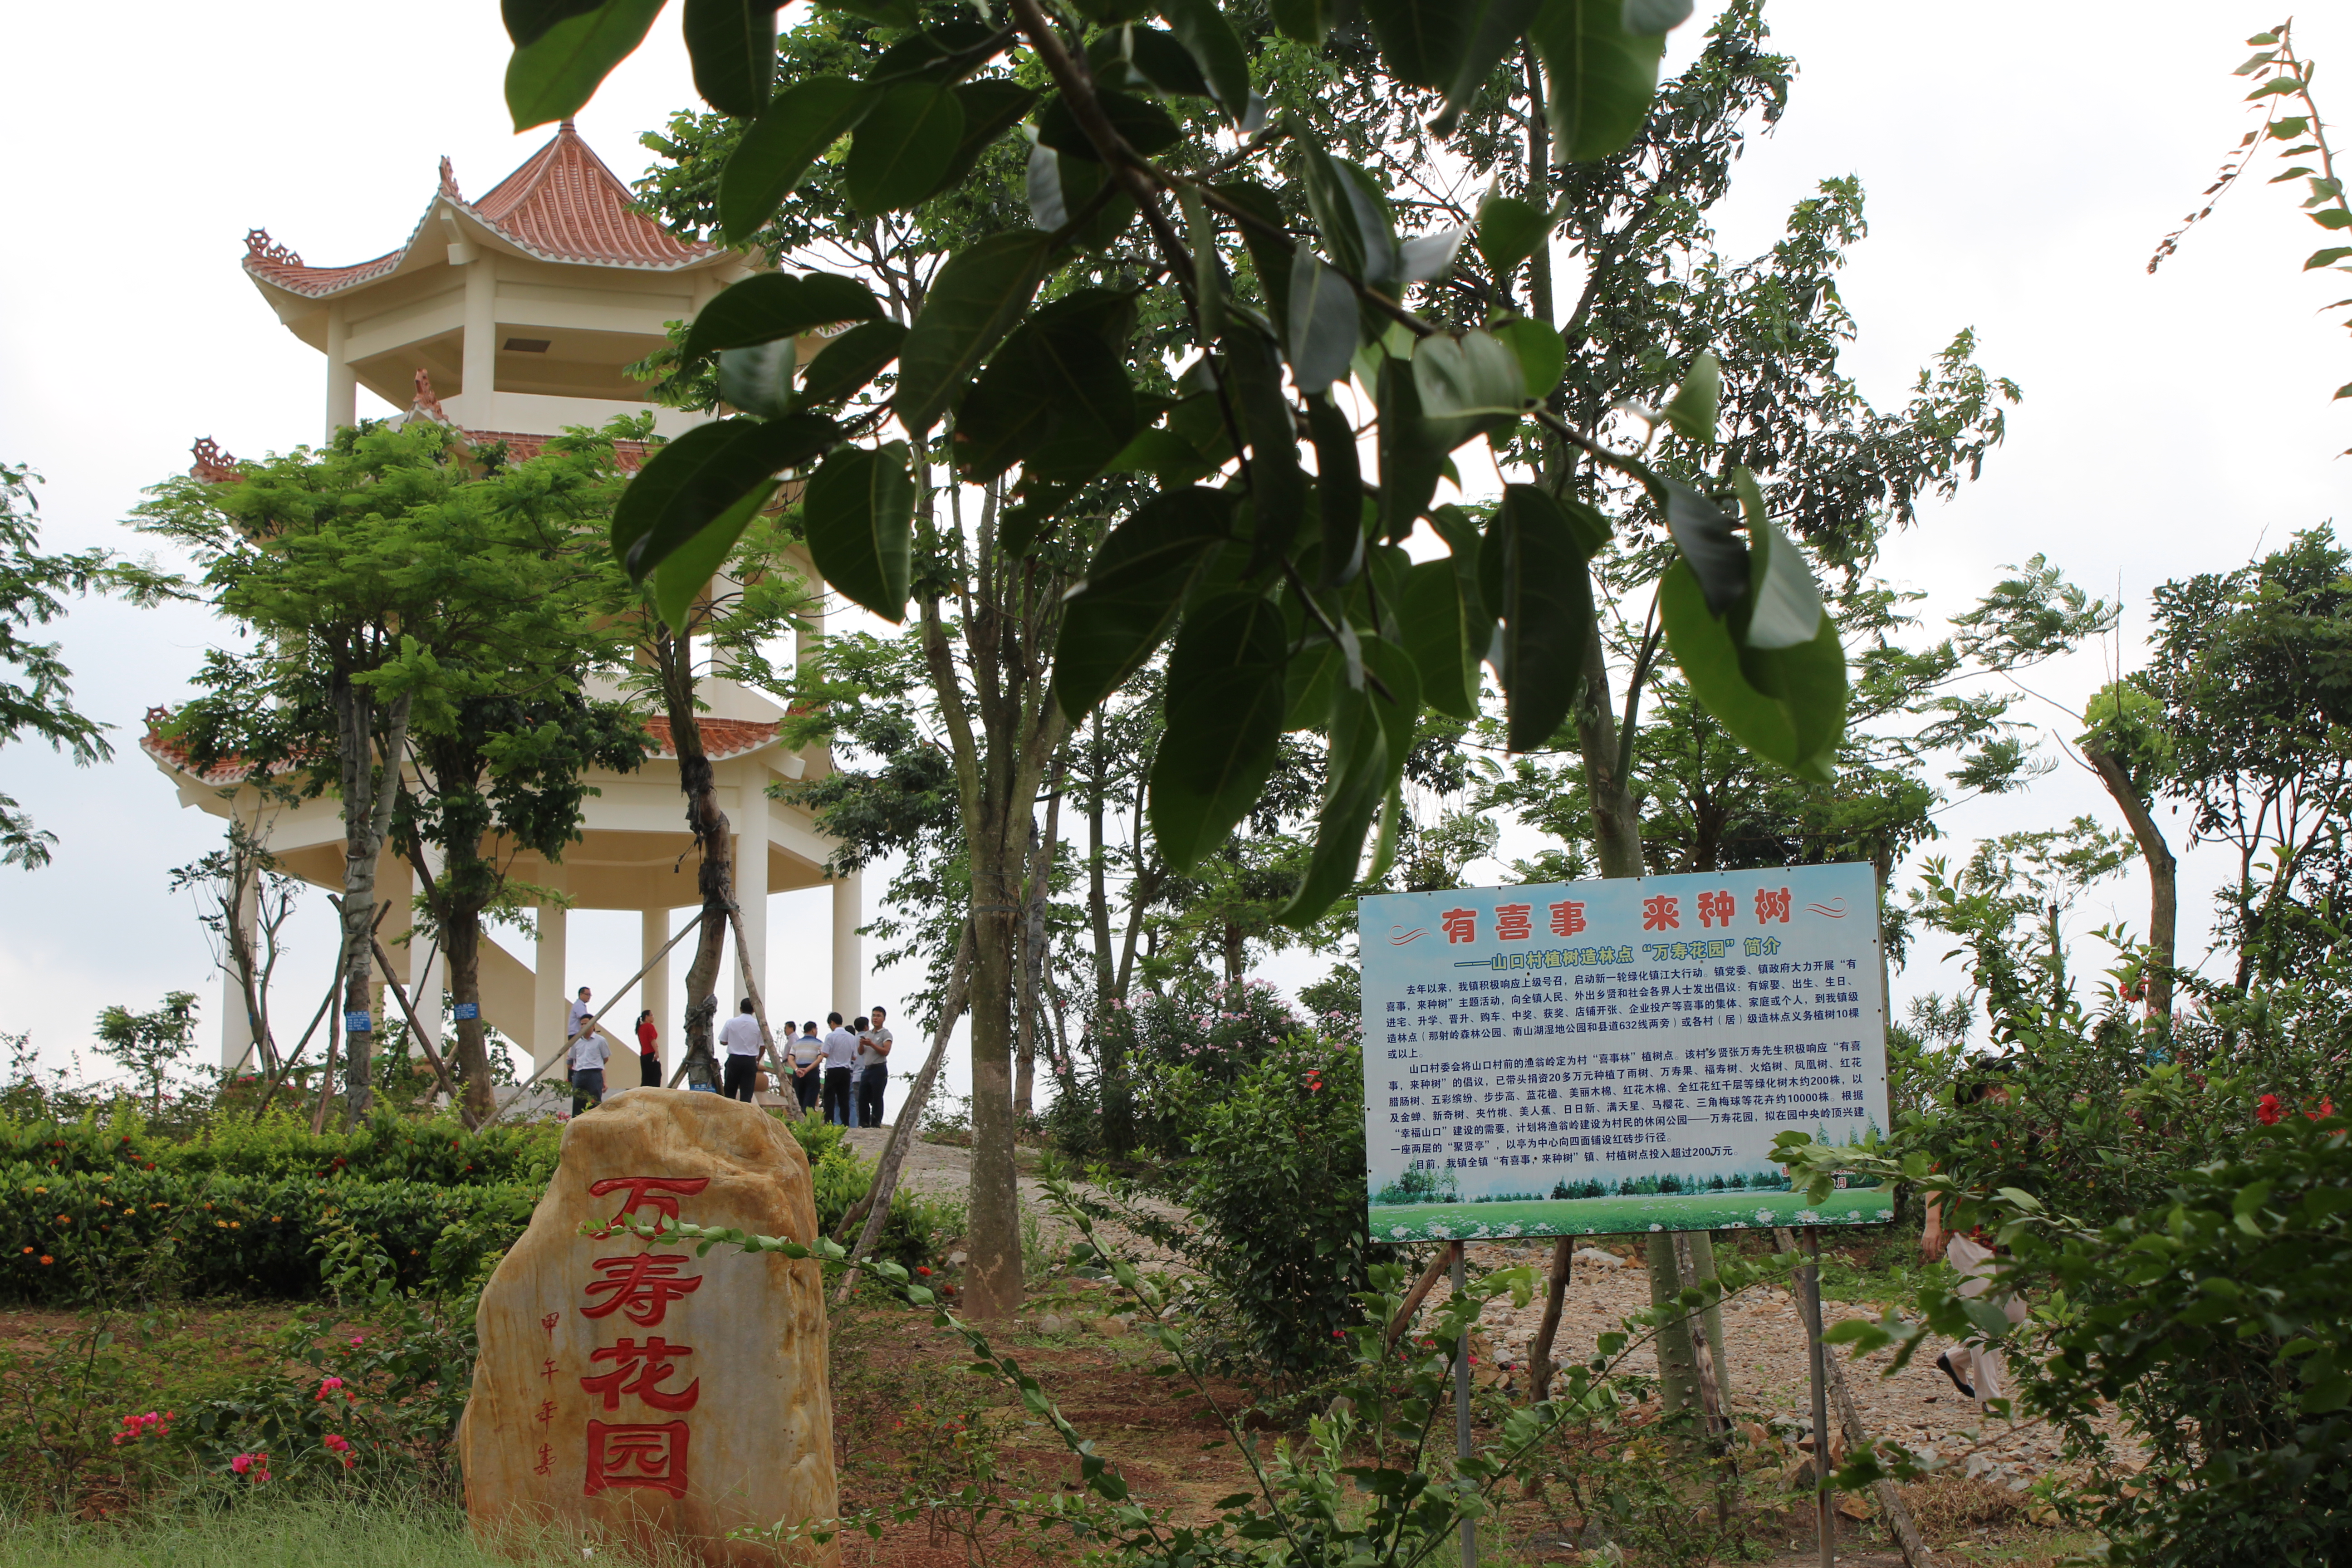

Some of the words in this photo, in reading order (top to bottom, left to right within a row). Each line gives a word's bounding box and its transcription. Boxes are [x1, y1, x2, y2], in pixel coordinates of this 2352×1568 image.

[1442, 901, 1587, 944] 有喜事
[1643, 887, 1791, 931] 来种树
[1387, 1048, 1423, 1059] 或以上。
[579, 1176, 710, 1500] 万寿花园
